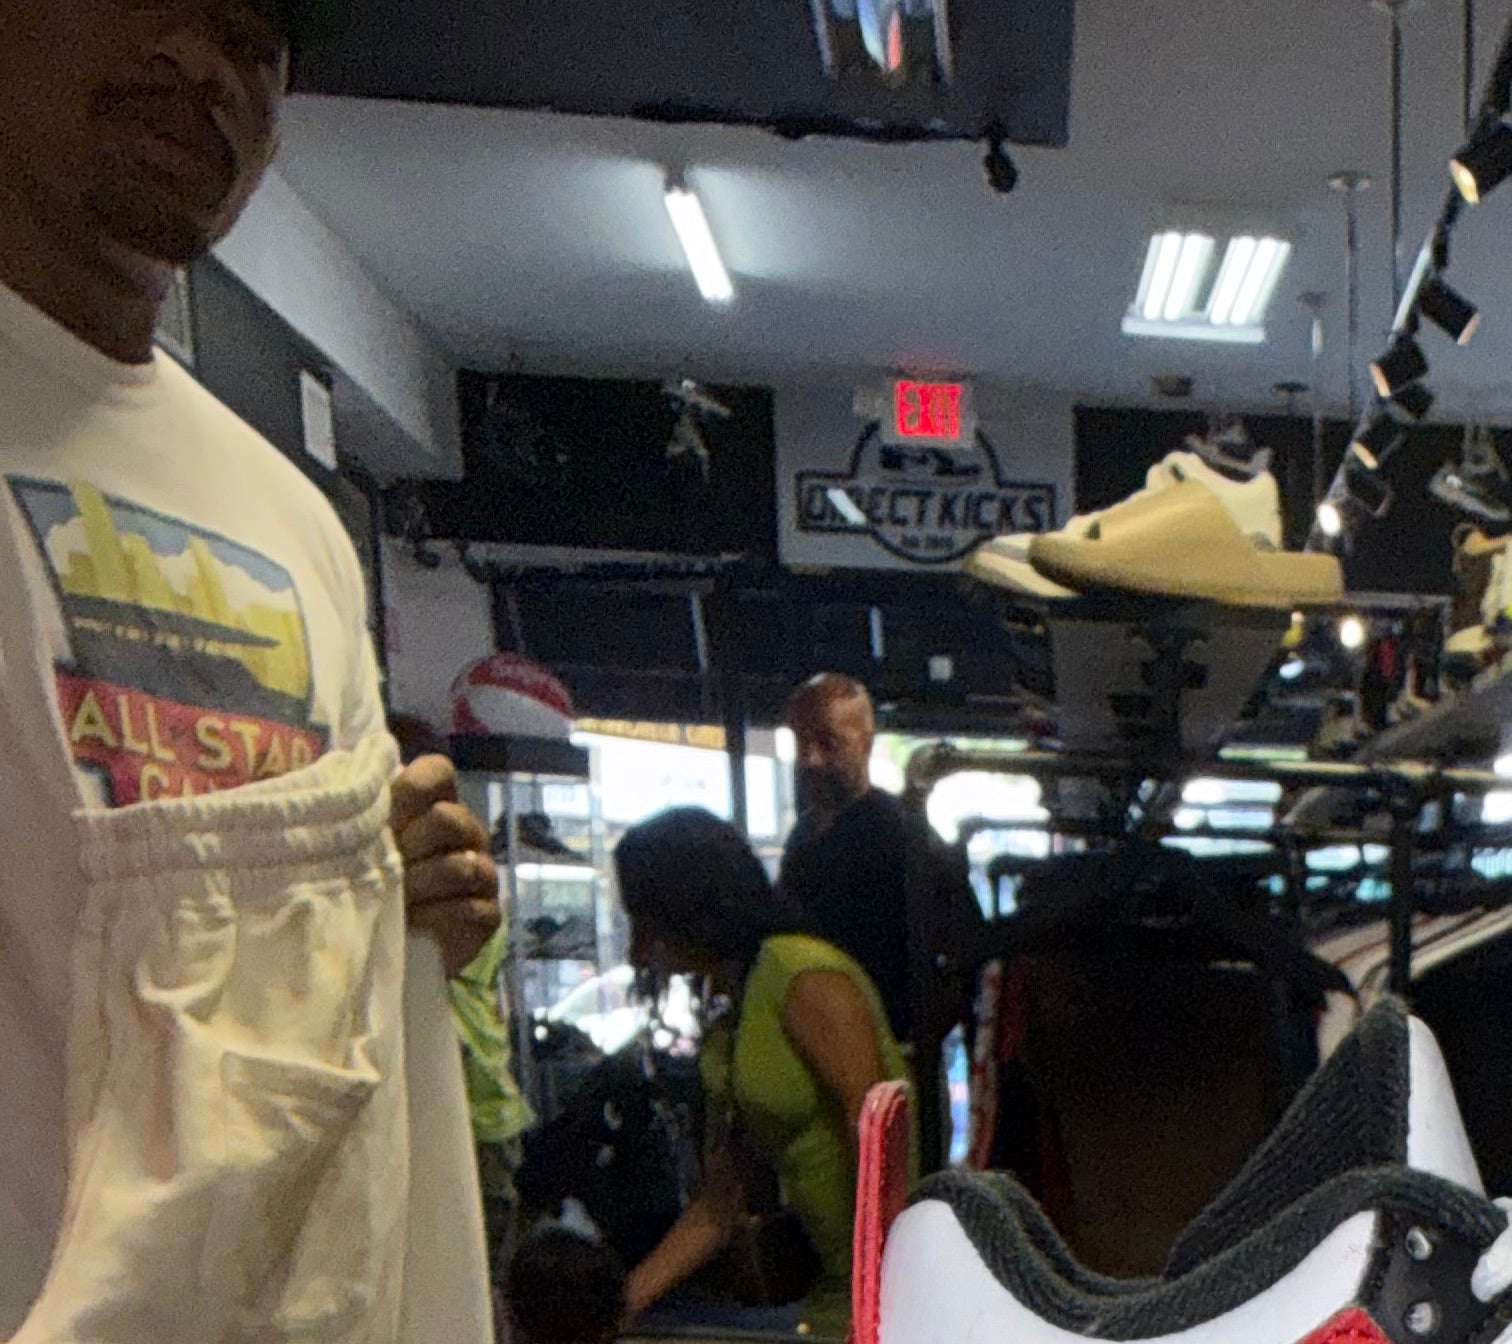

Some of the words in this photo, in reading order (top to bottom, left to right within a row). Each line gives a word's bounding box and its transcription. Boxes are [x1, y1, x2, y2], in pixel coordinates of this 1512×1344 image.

[895, 380, 964, 438] EXIT
[805, 486, 933, 526] DECT
[937, 490, 1046, 533] KICKS
[69, 689, 177, 762] ALL
